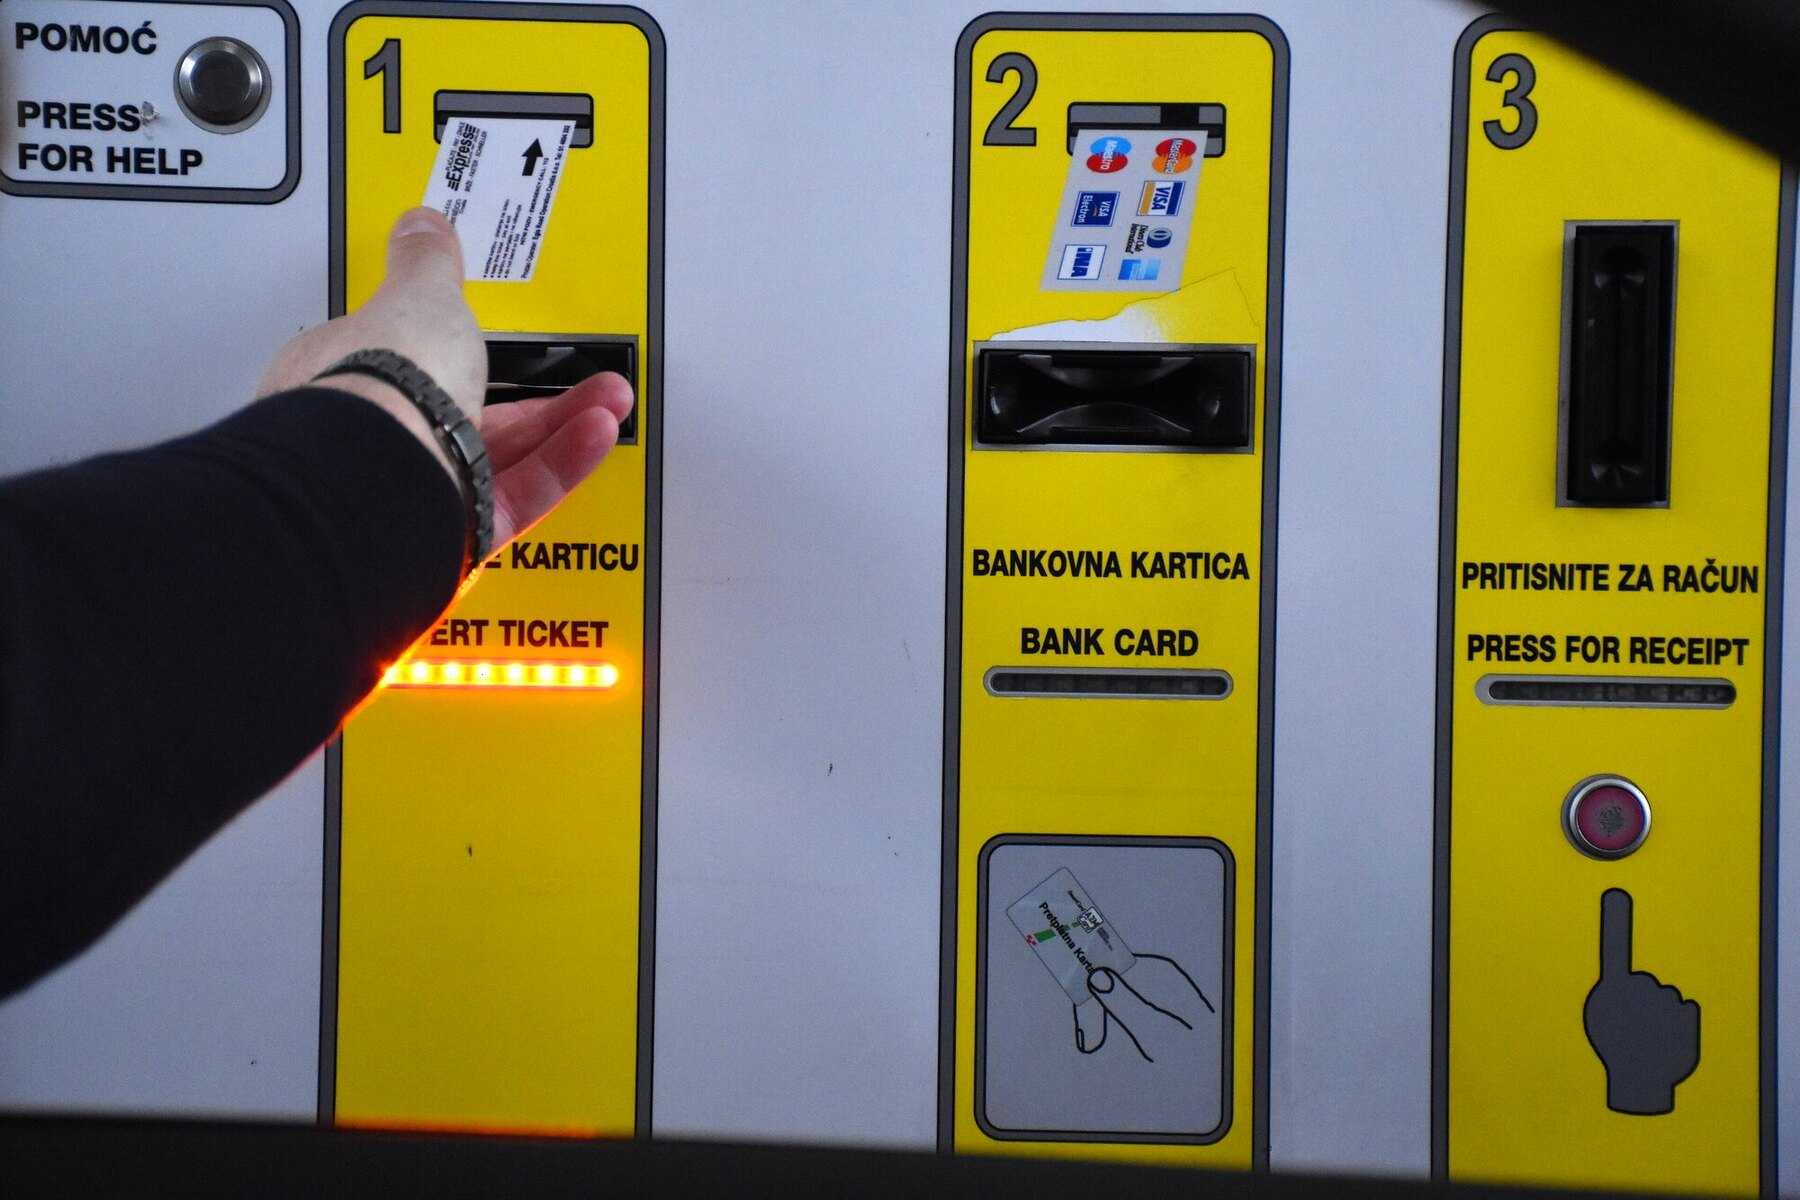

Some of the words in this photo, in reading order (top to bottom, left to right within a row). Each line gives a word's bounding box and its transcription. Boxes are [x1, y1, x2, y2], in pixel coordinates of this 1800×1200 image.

[15, 21, 157, 55] POMOĆ
[363, 38, 401, 134] 1
[982, 51, 1038, 146] 2
[1482, 52, 1538, 151] 3
[17, 100, 141, 132] PRESS
[18, 143, 94, 172] FOR
[107, 146, 203, 175] HELP
[445, 129, 475, 183] Express
[1077, 195, 1093, 222] Electron
[1098, 201, 1111, 217] VISA
[1151, 187, 1171, 210] VISA
[512, 542, 639, 571] KARTICU
[972, 549, 1122, 578] BANKOVNA
[1131, 552, 1250, 580] KARTICA
[1462, 562, 1610, 590] PRITISNITE
[1618, 565, 1654, 592] ZA
[1663, 558, 1759, 593] RAČUN
[498, 620, 609, 649] TICKET
[1021, 627, 1105, 655] BANK
[1114, 628, 1199, 656] CARD
[1467, 634, 1557, 662] PRESS
[1565, 636, 1620, 664] FOR
[1629, 637, 1750, 666] RECEIPT
